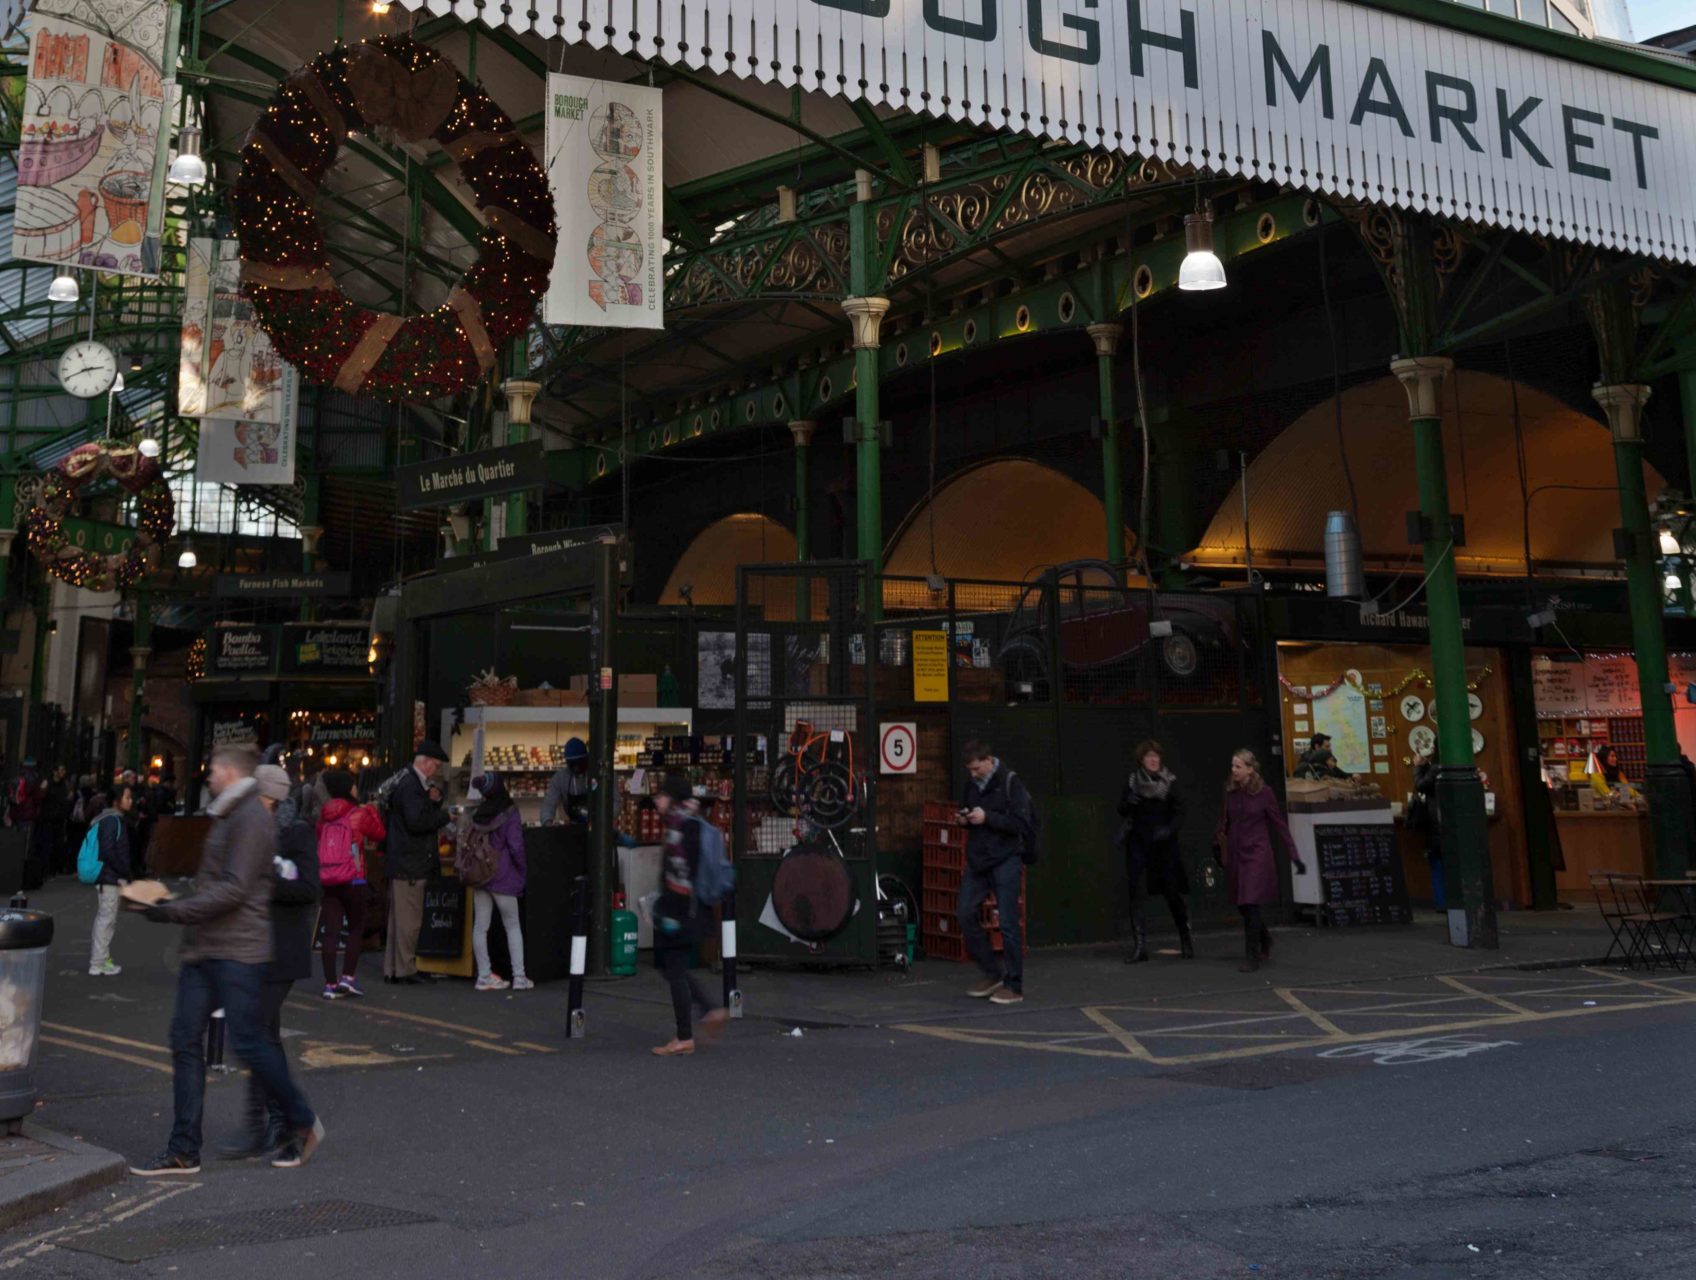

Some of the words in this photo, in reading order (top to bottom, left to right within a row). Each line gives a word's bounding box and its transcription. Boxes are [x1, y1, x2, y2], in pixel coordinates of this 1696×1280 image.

[555, 94, 588, 110] BOROUGH
[1262, 29, 1659, 189] MARKET
[555, 106, 584, 120] MARKET
[646, 108, 655, 172] SOUTHWARK
[647, 175, 654, 185] IN
[647, 187, 655, 220] YEARS
[648, 243, 656, 311] CELEBRATING
[420, 475, 431, 492] Le
[432, 468, 463, 490] Marché
[465, 466, 477, 484] du
[478, 459, 515, 485] Quartier
[240, 579, 270, 589] Furness
[272, 577, 289, 588] Fish
[291, 577, 324, 588] Markets
[223, 631, 262, 644] Bomba
[894, 739, 903, 756] 5
